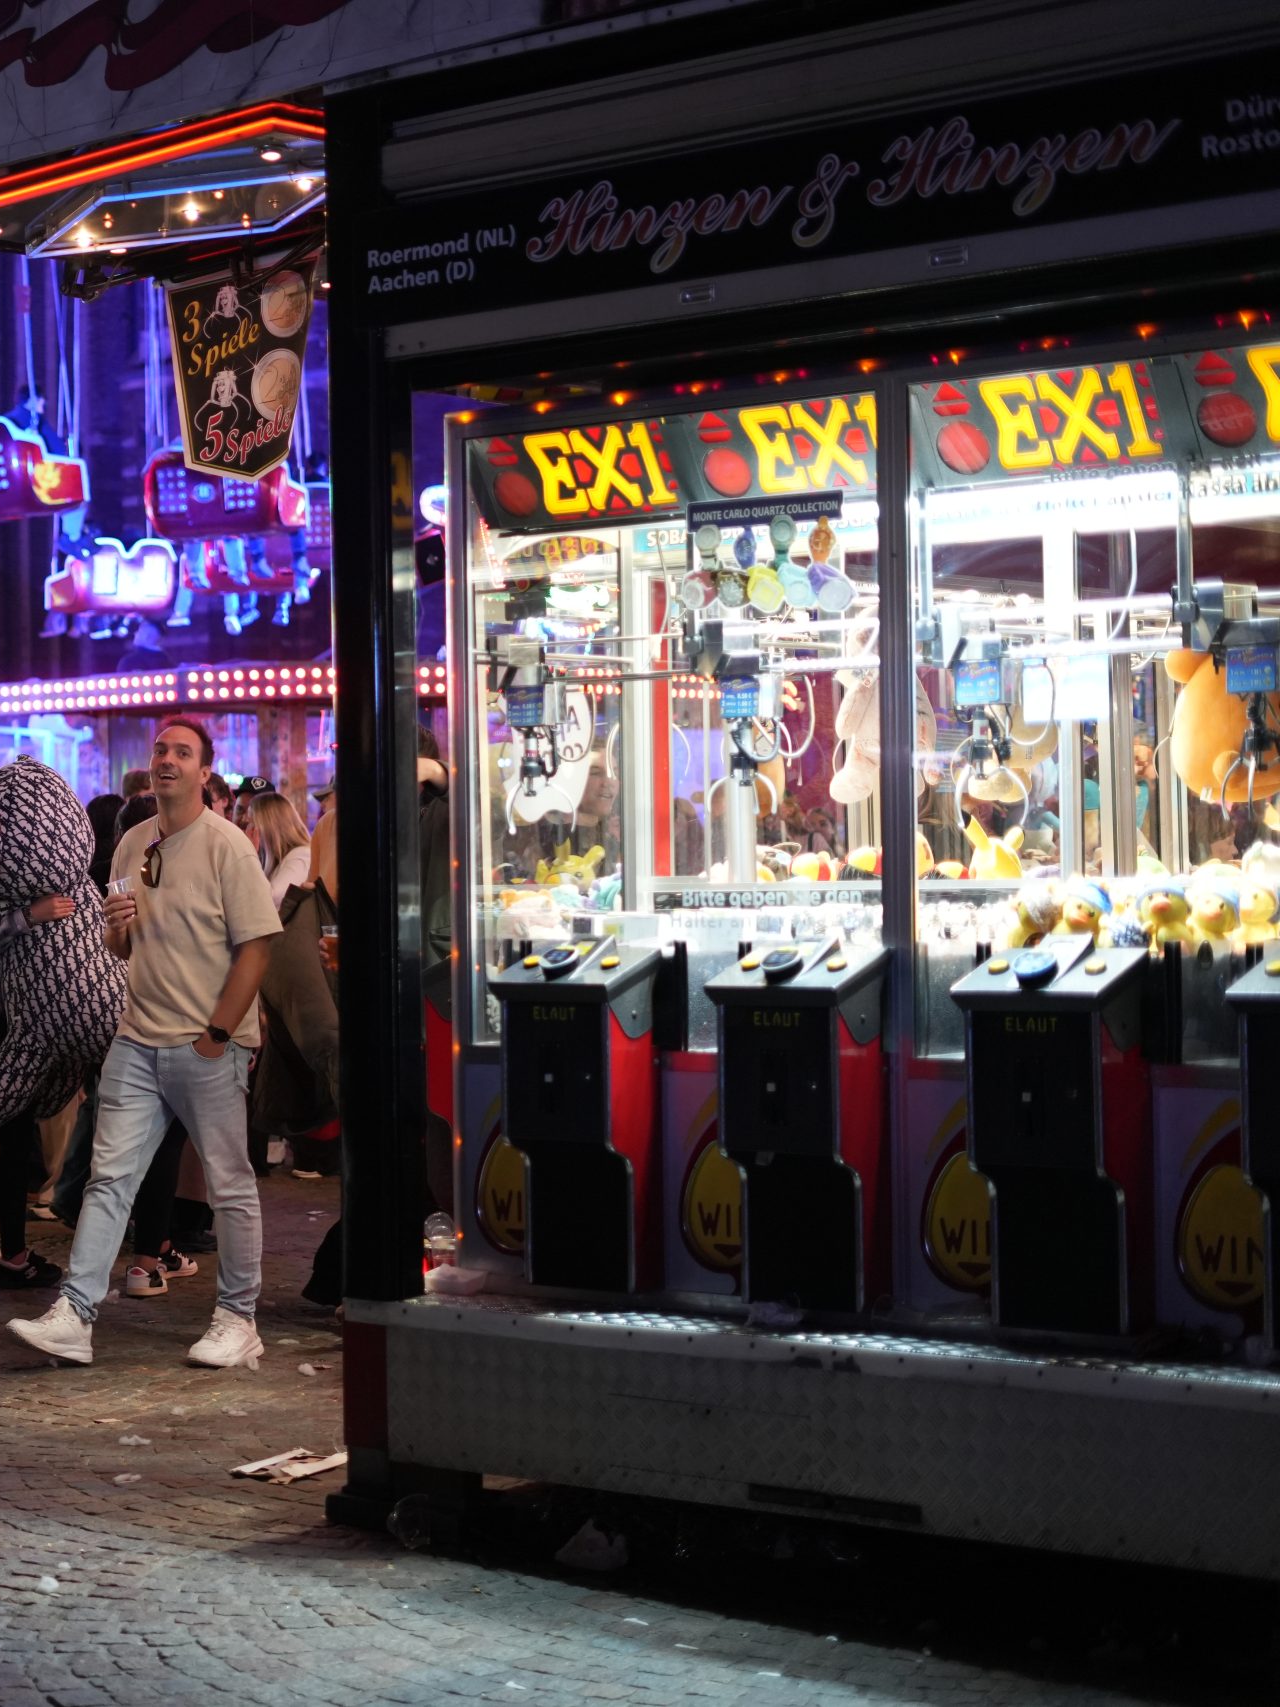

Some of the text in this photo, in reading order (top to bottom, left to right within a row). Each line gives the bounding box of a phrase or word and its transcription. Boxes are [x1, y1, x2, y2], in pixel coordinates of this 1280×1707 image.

[1201, 129, 1280, 160] Rosto
[525, 116, 1183, 273] Hinzen & Hinzen
[367, 224, 516, 268] Roermond (NL)
[368, 258, 475, 294] Aachen (D)
[183, 301, 201, 343] 3
[187, 317, 260, 377] Spiele
[199, 404, 291, 464] 5 Spiele
[979, 362, 1163, 471] EX1
[523, 421, 678, 515] EX1
[693, 500, 839, 522] MONTE CARLO QUARTZ COLLECTION
[682, 890, 725, 907] Bitte
[729, 890, 787, 909] geben
[698, 1203, 742, 1237] WI
